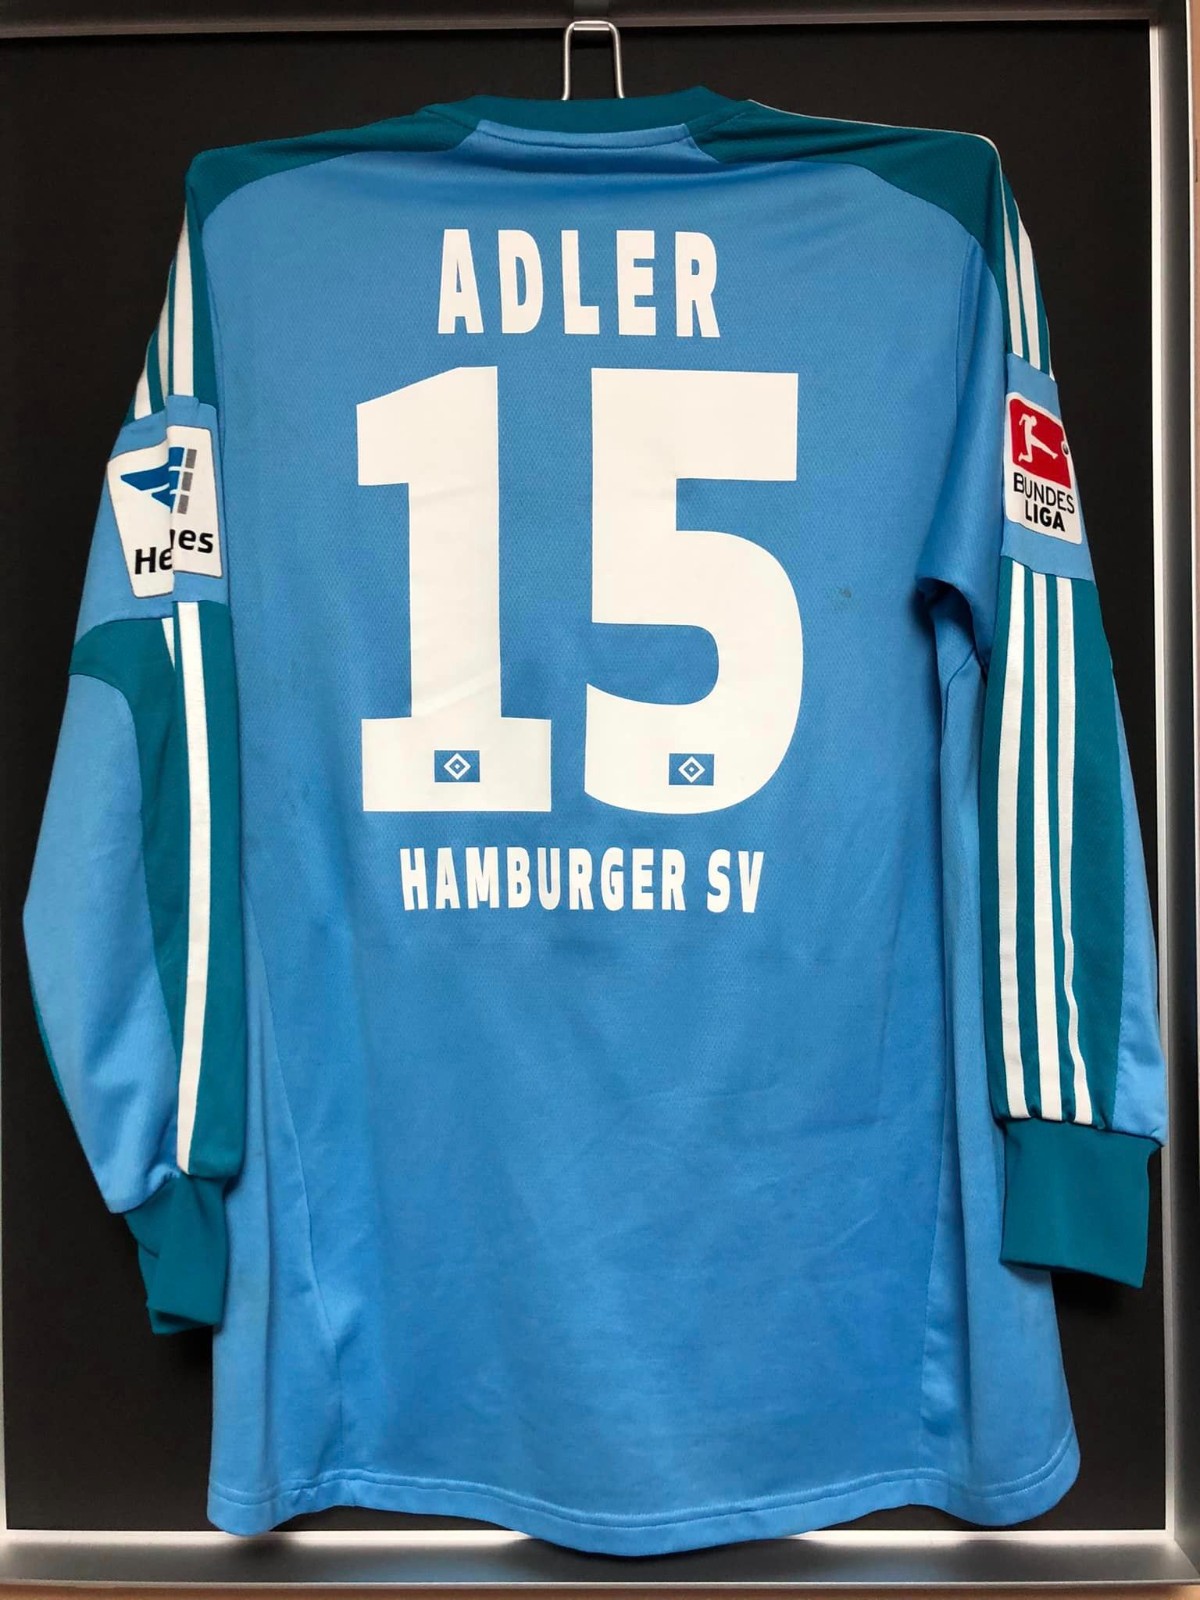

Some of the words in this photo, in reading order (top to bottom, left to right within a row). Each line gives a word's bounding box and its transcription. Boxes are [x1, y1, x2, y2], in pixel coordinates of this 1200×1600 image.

[438, 229, 721, 338] ADLER
[1013, 472, 1075, 515] BUNDES
[1024, 500, 1066, 532] LIGA
[356, 366, 804, 814] 15
[400, 846, 687, 911] HAMBURGER
[706, 848, 765, 913] SV
